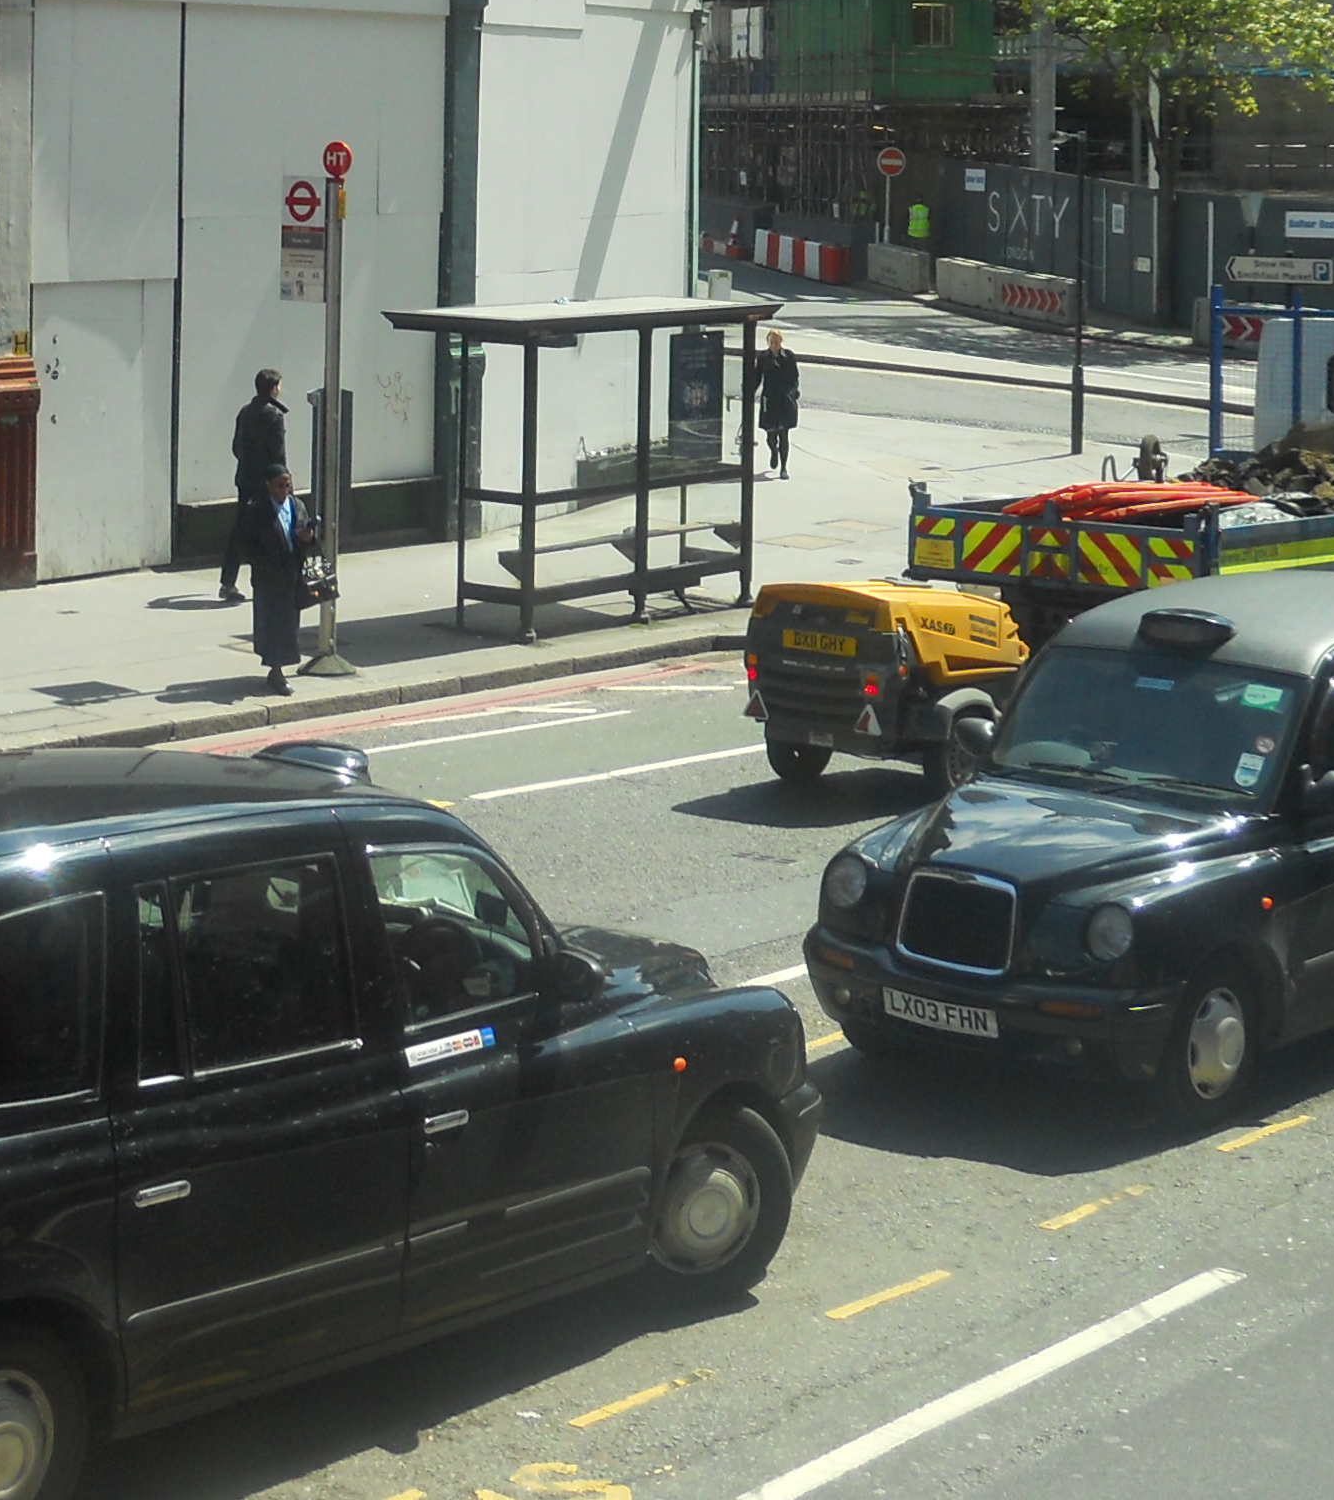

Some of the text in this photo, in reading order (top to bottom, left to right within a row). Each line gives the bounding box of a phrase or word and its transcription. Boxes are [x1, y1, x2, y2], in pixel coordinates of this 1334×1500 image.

[326, 151, 347, 166] HT
[820, 634, 846, 653] GHY
[890, 991, 988, 1031] LX03 FHN
